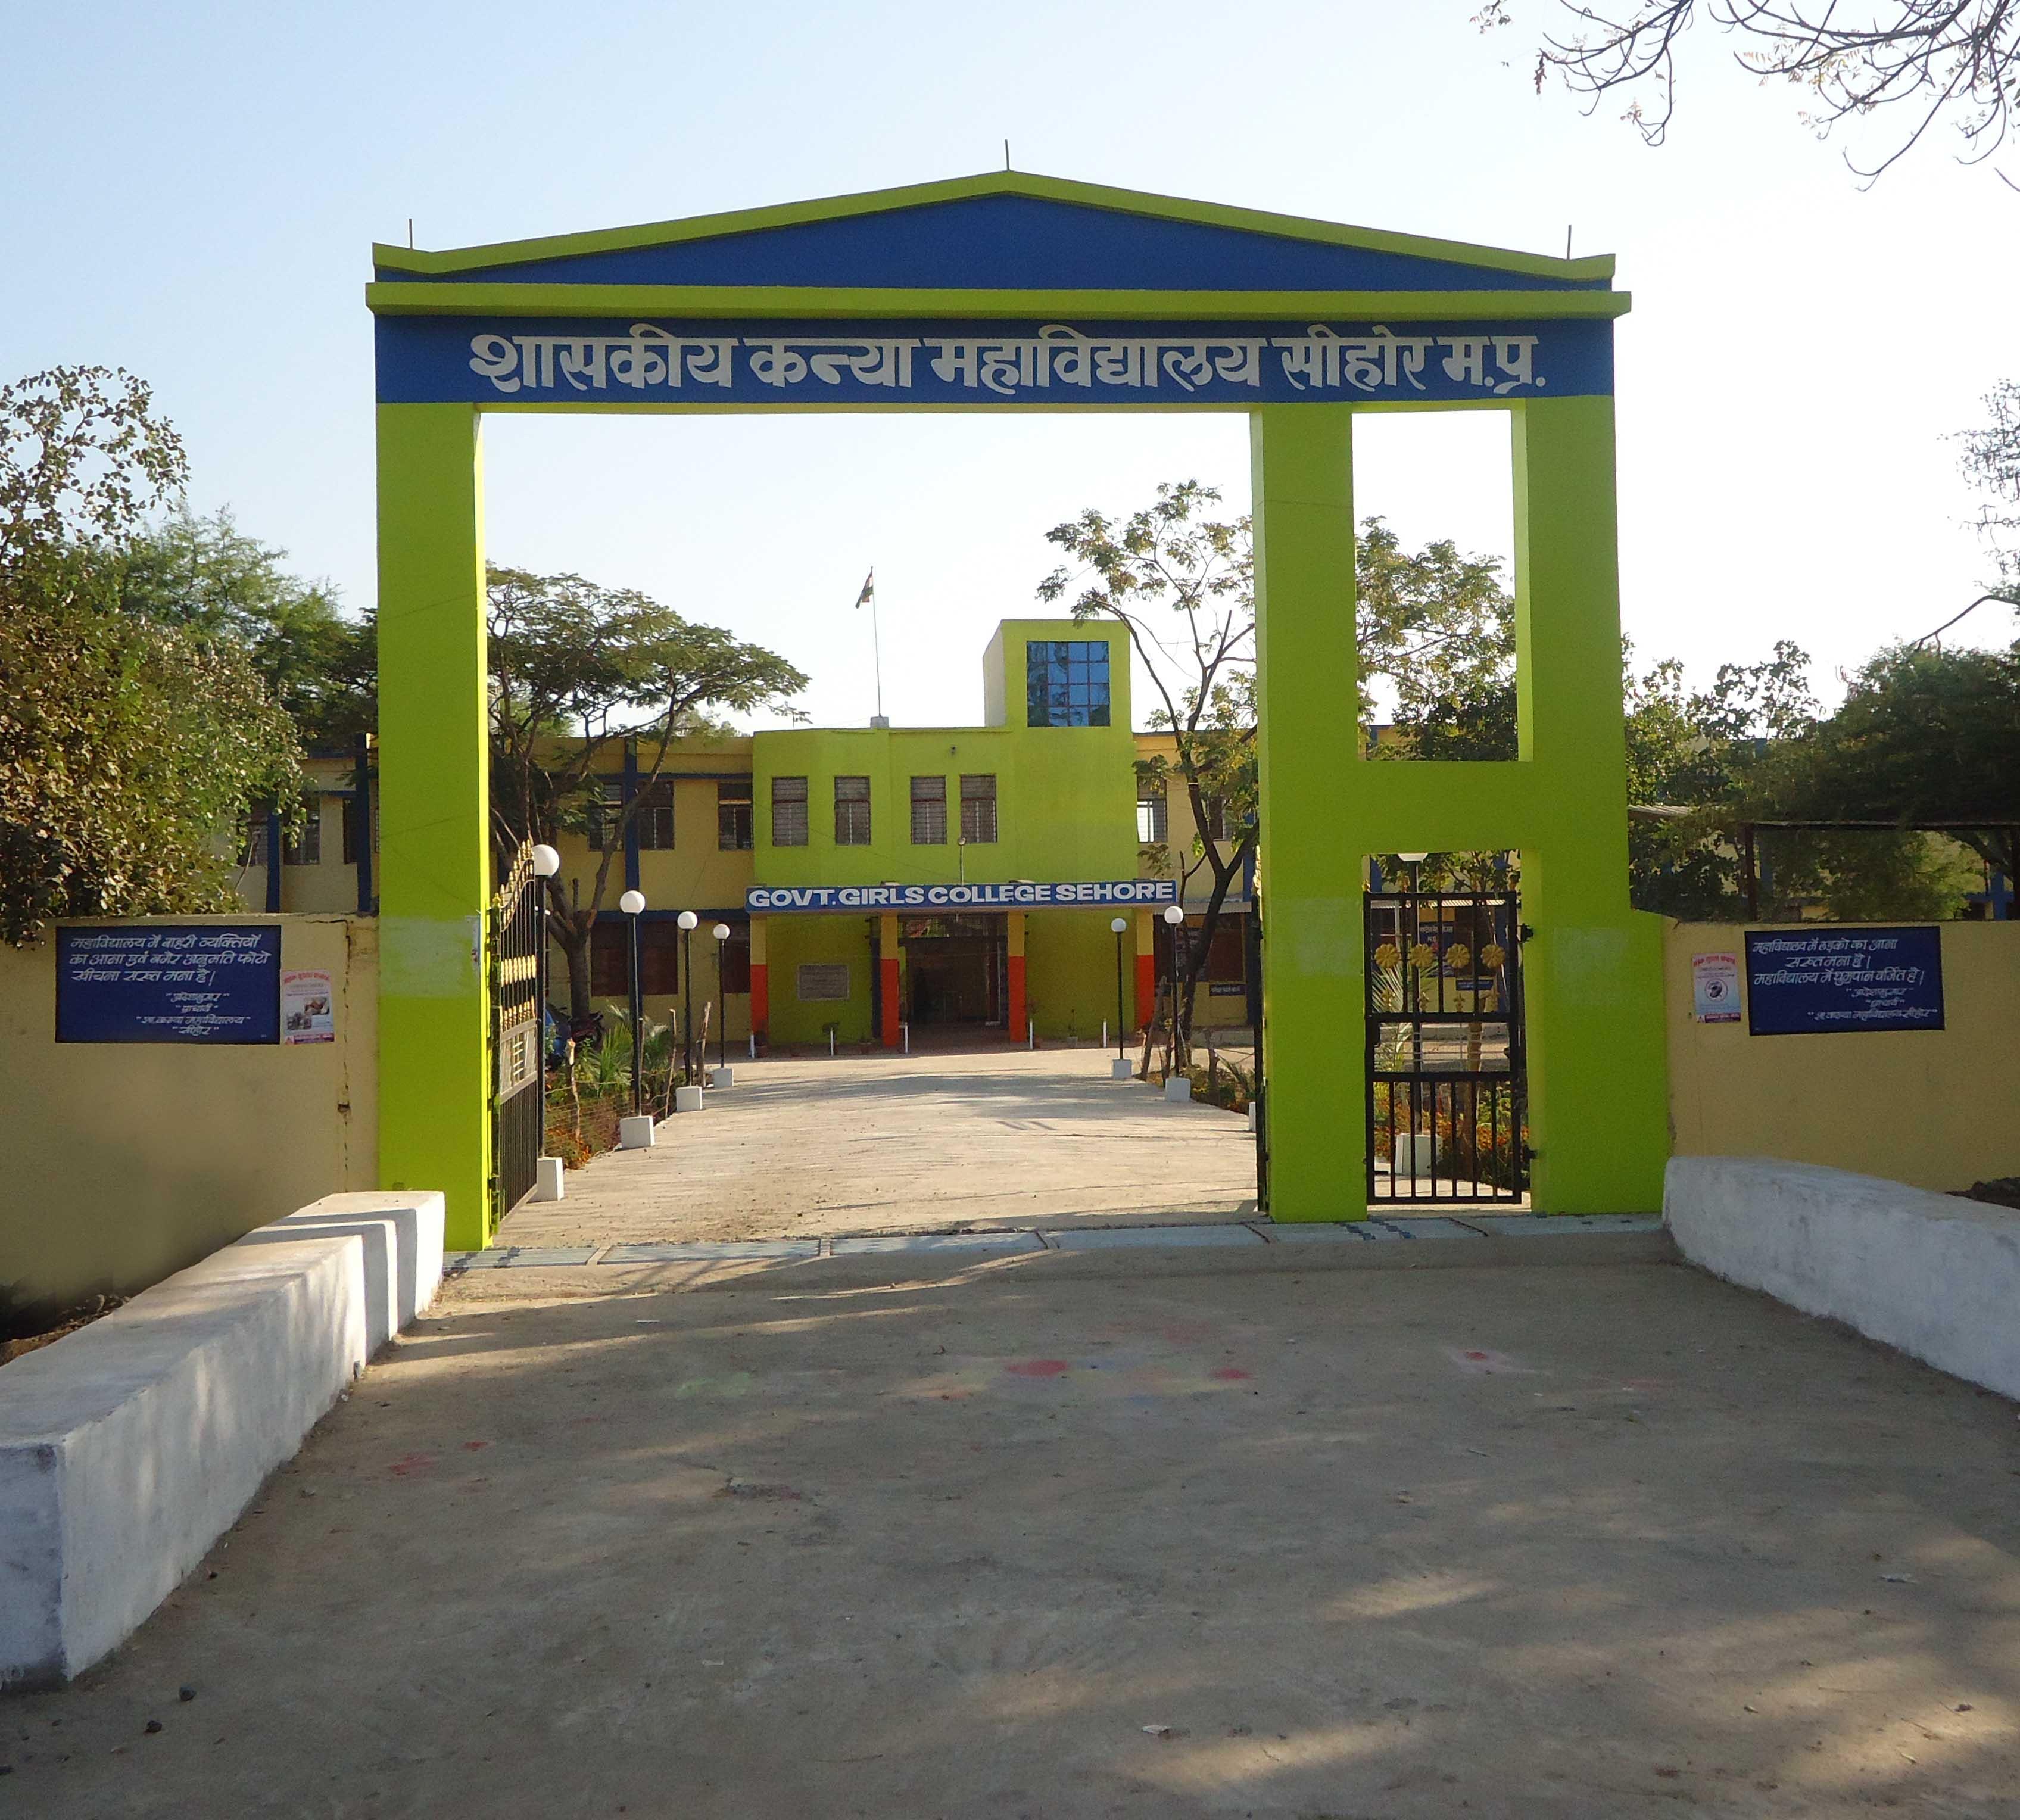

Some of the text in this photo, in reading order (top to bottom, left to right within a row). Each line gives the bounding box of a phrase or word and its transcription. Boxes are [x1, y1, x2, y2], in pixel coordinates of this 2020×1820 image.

[469, 323, 737, 393] शासकीय
[744, 337, 922, 387] कन्या
[926, 325, 1267, 395] महाविद्यालय
[1272, 323, 1433, 394] सीहोर
[748, 882, 1173, 906] GOVT. GIRLS COLLEGE SEHORE
[70, 934, 147, 949] महाविद्यालय
[161, 934, 197, 949] बाहरी
[1850, 940, 1868, 950] का
[1868, 939, 1899, 951] आना
[69, 953, 89, 965] का
[89, 953, 126, 965] आना
[183, 950, 238, 968] अनुमति
[1823, 955, 1851, 967] मना
[163, 970, 195, 981] मना
[1754, 970, 1818, 986] महाविद्यालय
